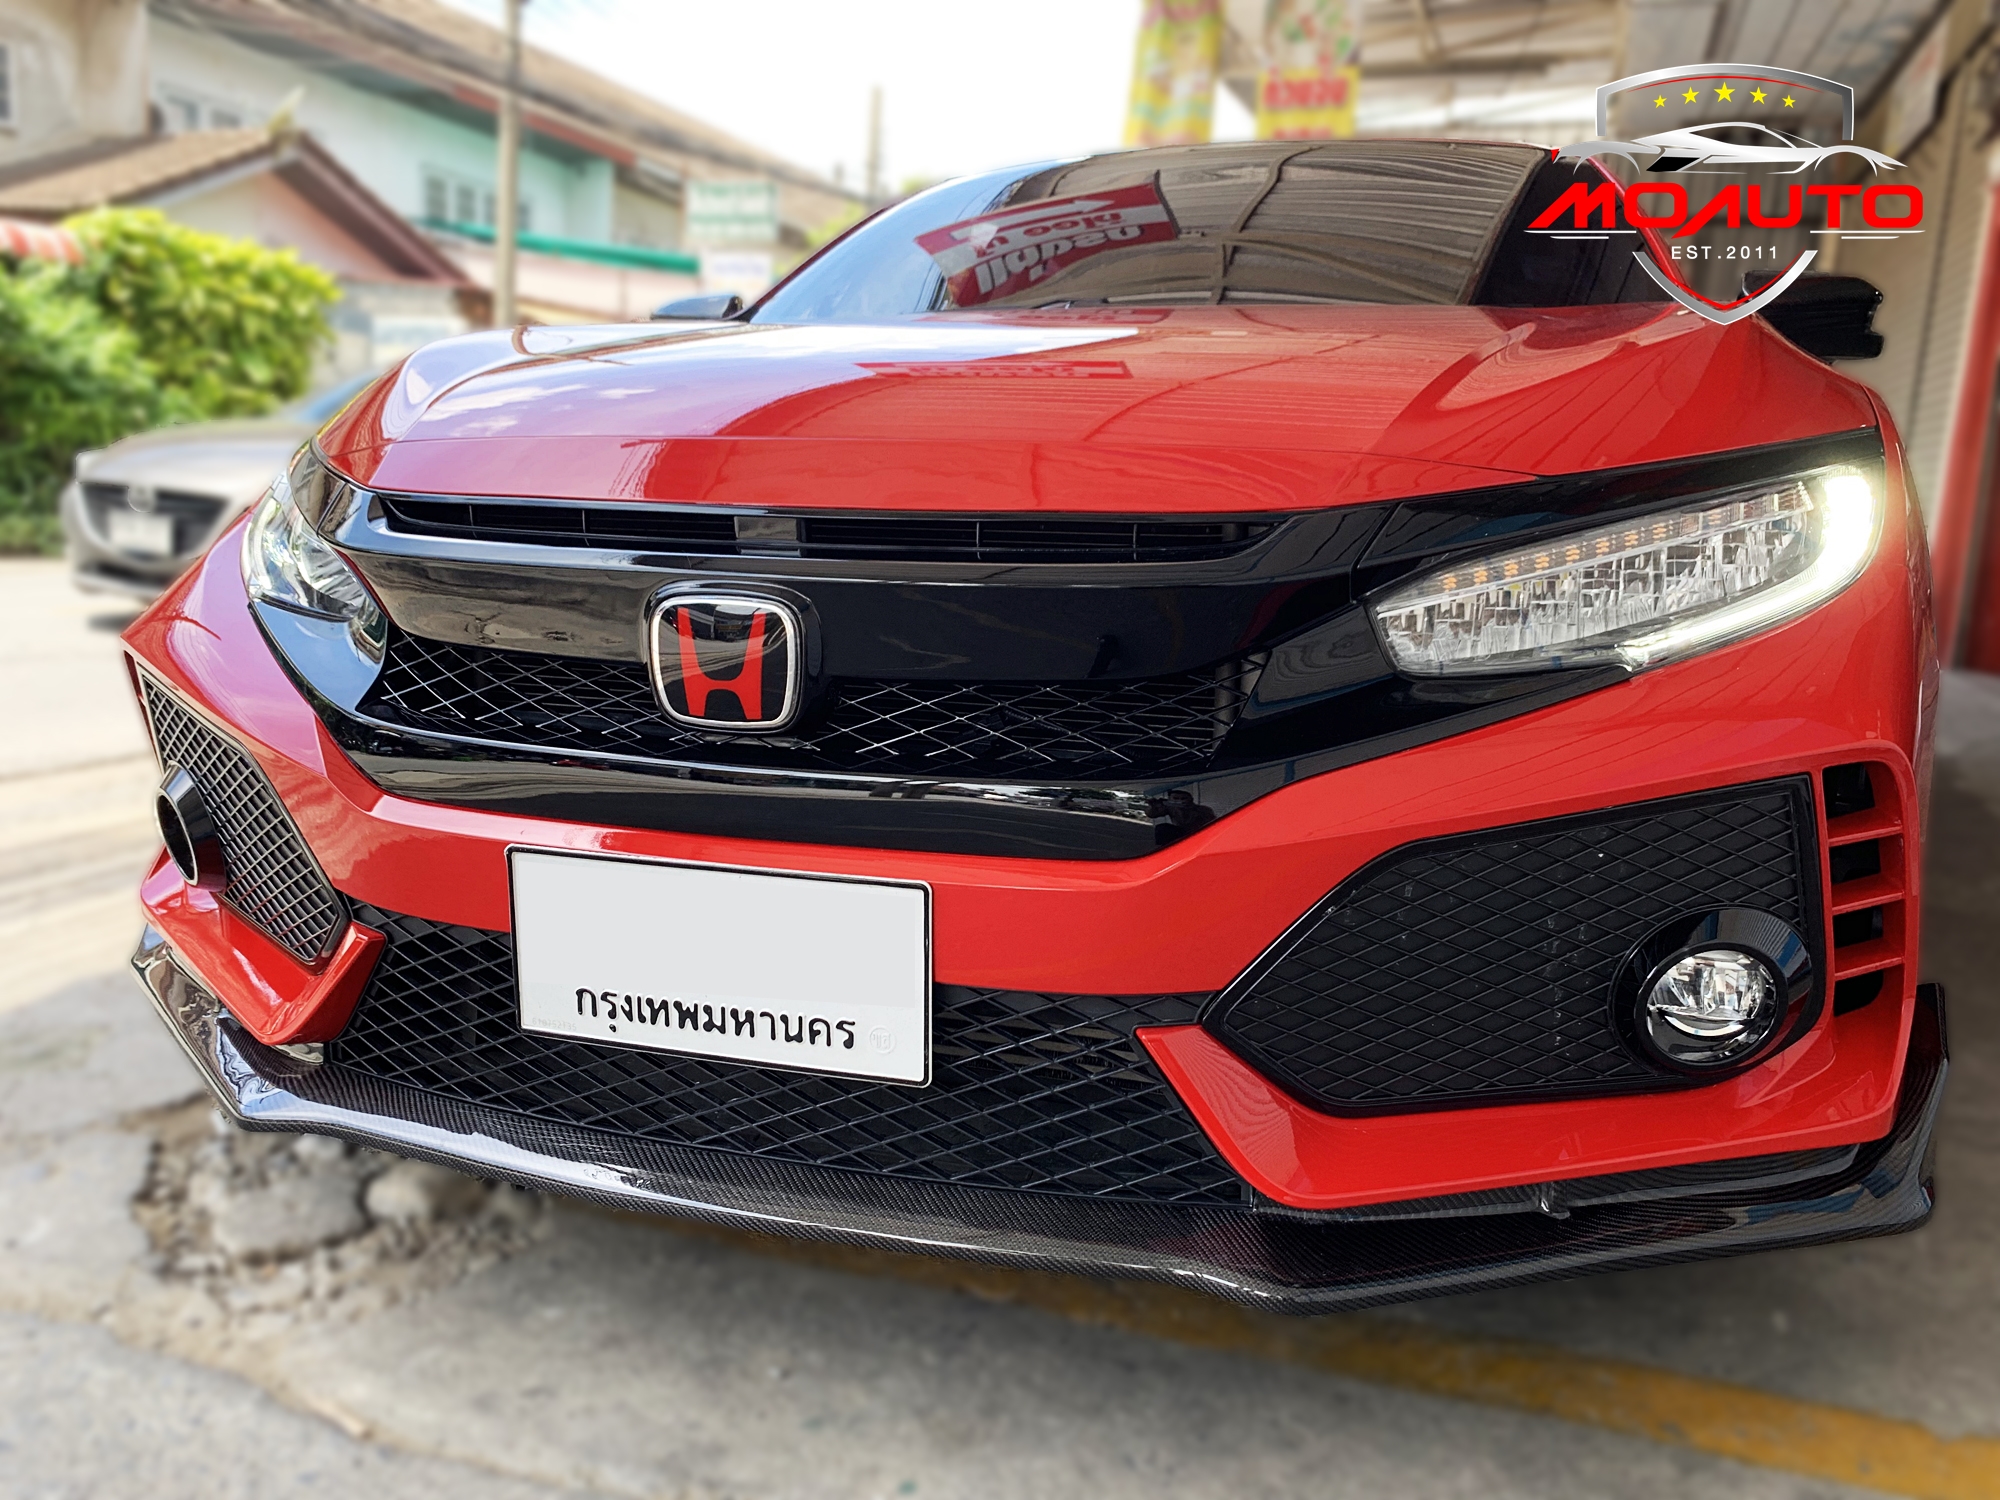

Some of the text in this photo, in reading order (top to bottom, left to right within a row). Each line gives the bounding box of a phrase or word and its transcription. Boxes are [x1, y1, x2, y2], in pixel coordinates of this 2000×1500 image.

[677, 607, 767, 720] H
[576, 987, 856, 1049] กรุงเทพมหานคร
